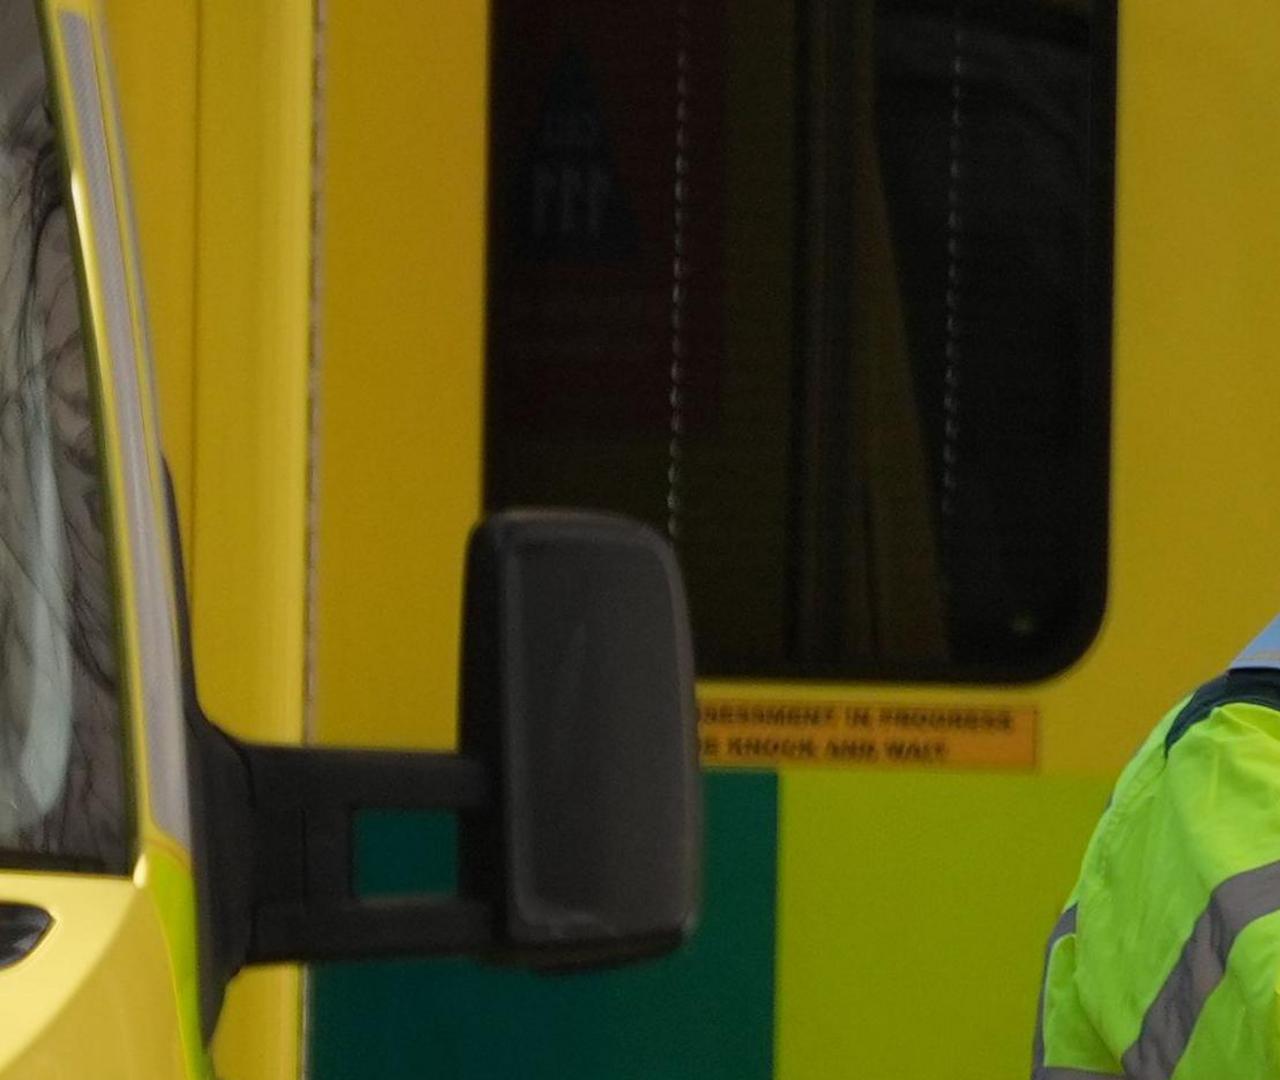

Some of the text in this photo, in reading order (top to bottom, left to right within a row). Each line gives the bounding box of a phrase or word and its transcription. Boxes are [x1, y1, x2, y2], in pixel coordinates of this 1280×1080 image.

[845, 708, 870, 727] IN
[880, 707, 1012, 731] PROGRESS
[727, 737, 816, 757] KNOCK
[827, 739, 875, 760] AND
[886, 740, 947, 760] WAIT
